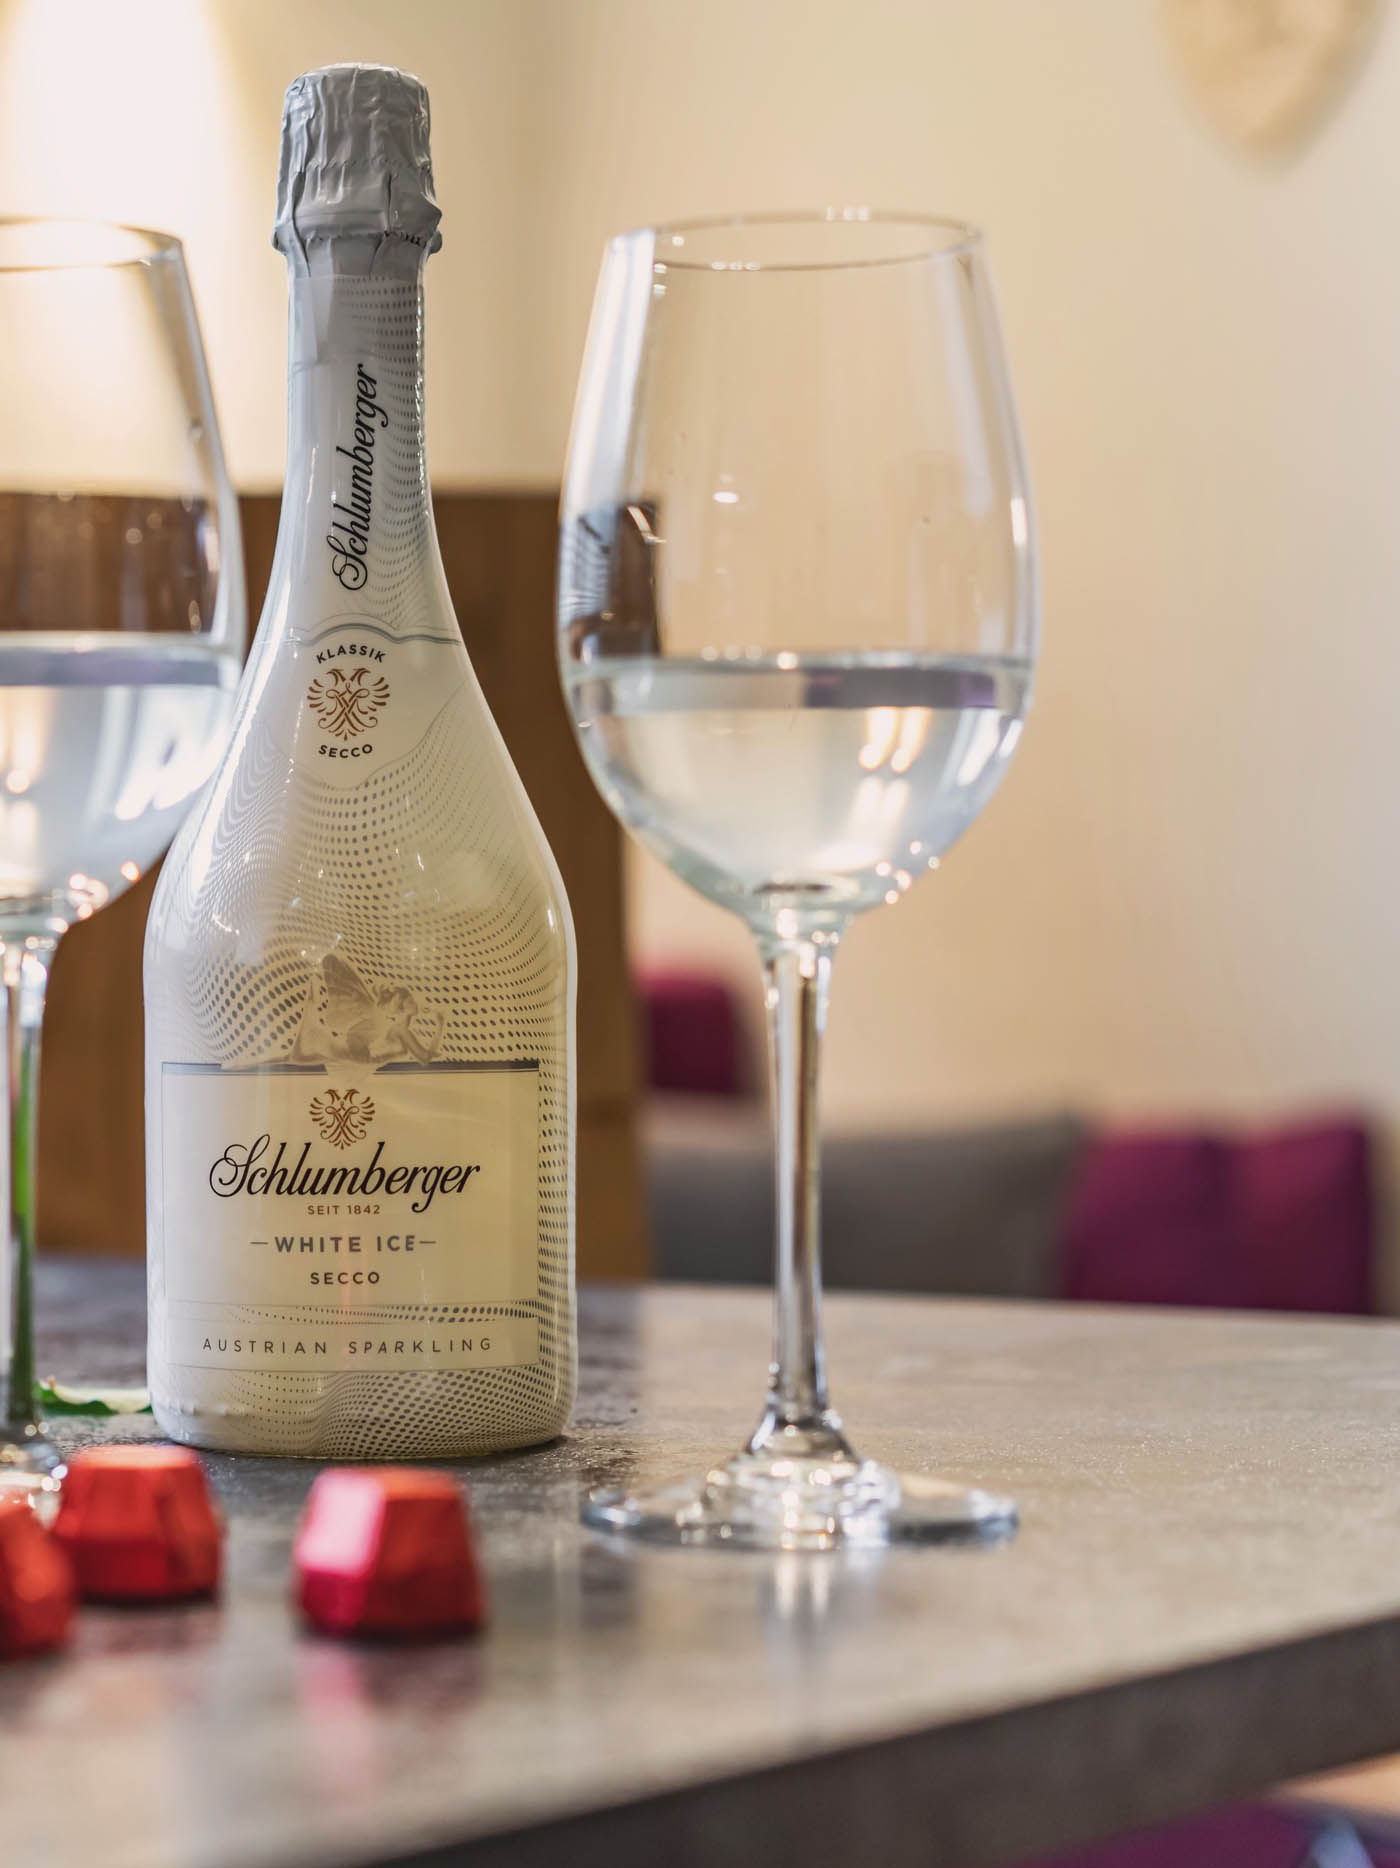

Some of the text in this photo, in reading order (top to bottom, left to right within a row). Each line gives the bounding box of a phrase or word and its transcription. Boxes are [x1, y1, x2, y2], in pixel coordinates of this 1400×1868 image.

[326, 363, 388, 592] Schlumberger
[315, 643, 387, 665] KLASSIK
[318, 743, 374, 760] SECCO
[208, 1133, 481, 1214] Schlumberger
[307, 1204, 381, 1216] SEIT 1842
[274, 1234, 416, 1253] WHITE ICE
[310, 1271, 381, 1286] SECCO
[202, 1337, 492, 1355] AUSTRIAN SPARKLING
